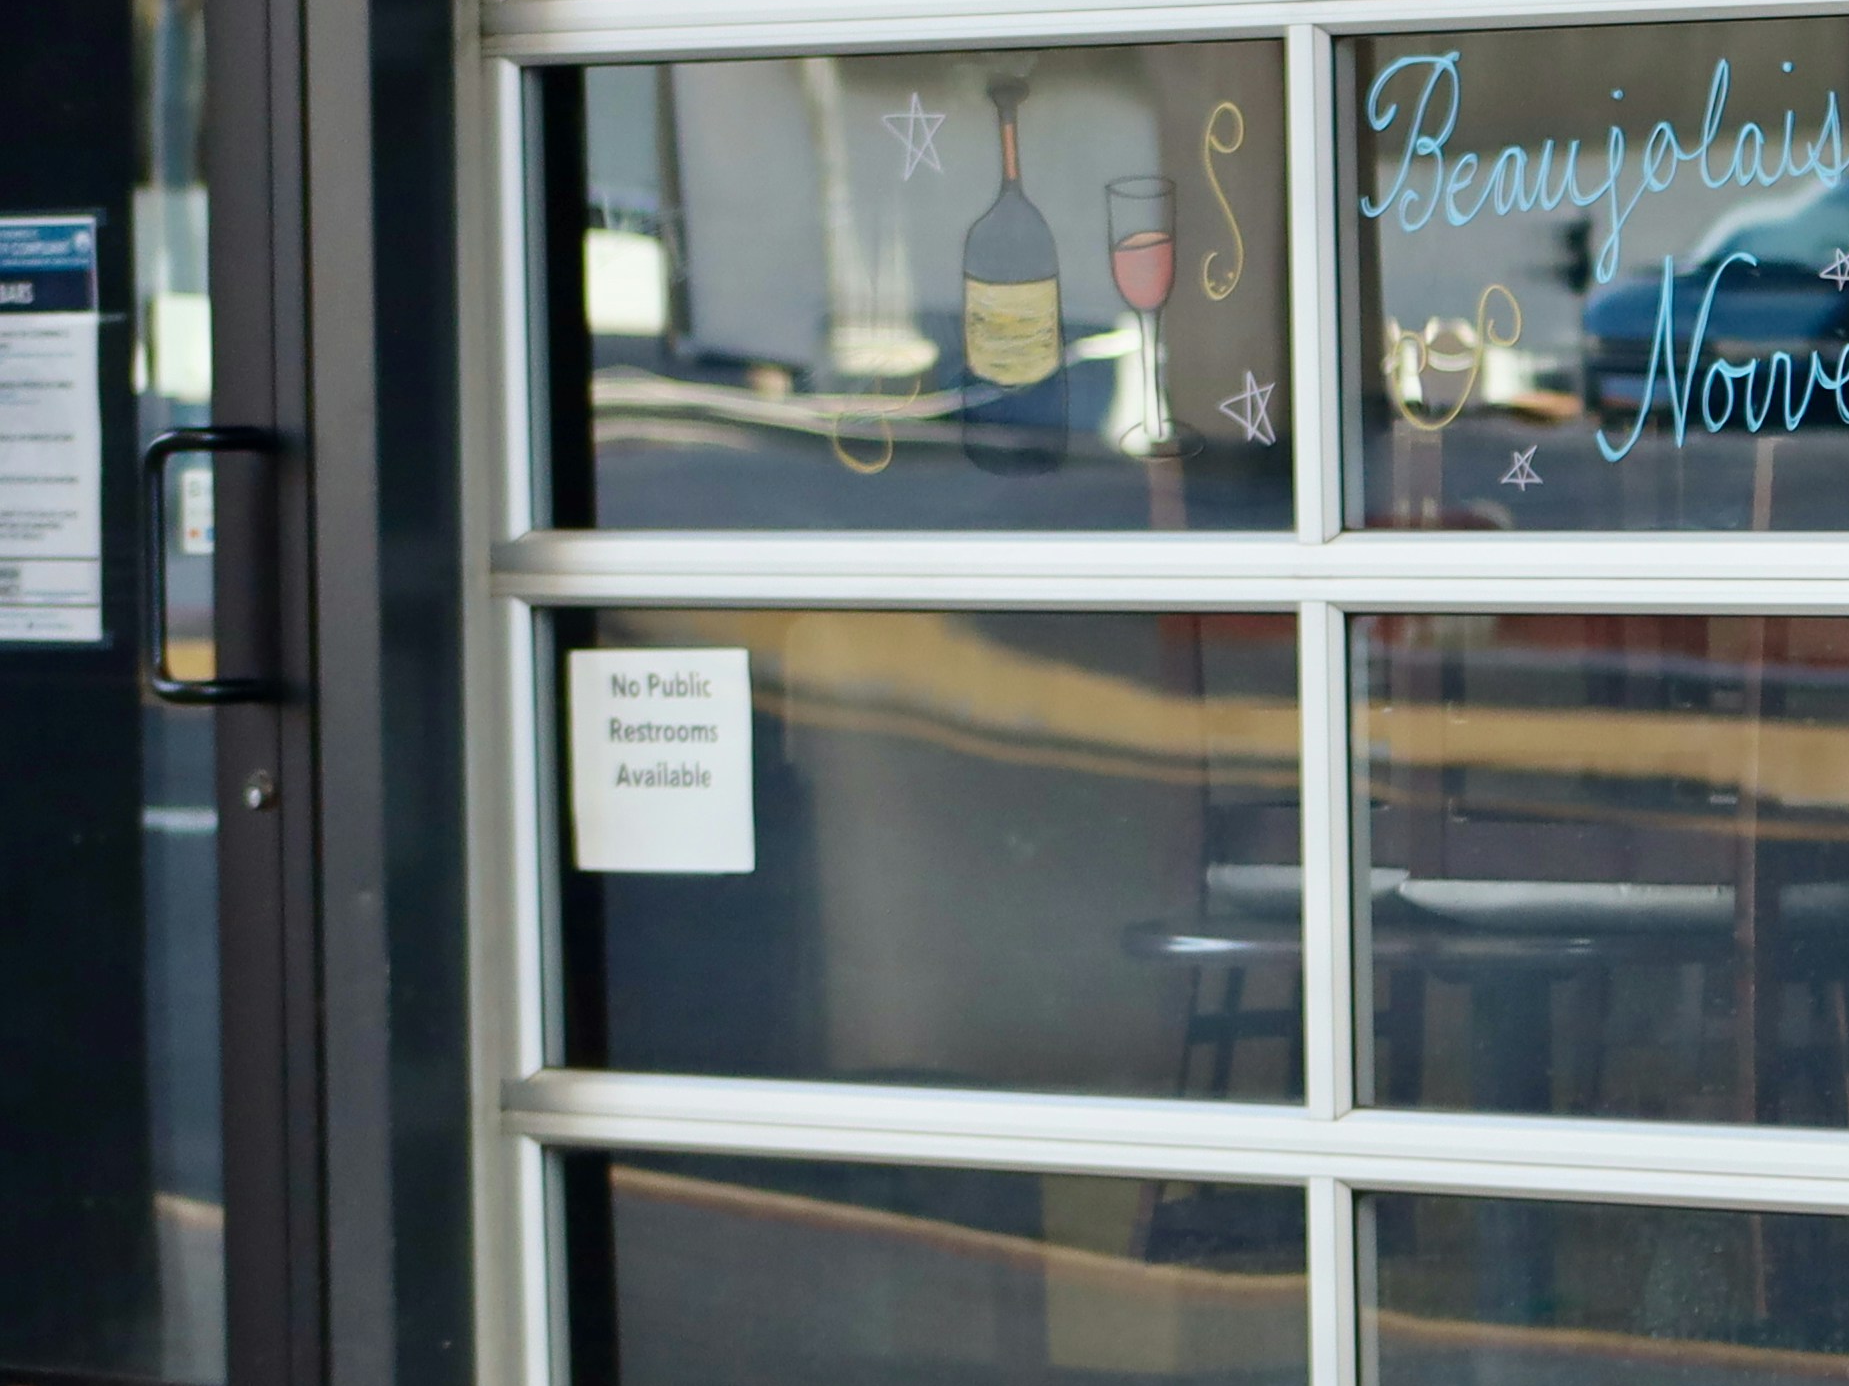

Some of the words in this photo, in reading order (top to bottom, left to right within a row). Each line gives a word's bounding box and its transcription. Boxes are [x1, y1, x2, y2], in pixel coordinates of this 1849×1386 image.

[610, 673, 642, 699] No
[647, 671, 712, 699] Public
[608, 716, 718, 744] Restrooms
[614, 762, 712, 789] Available
